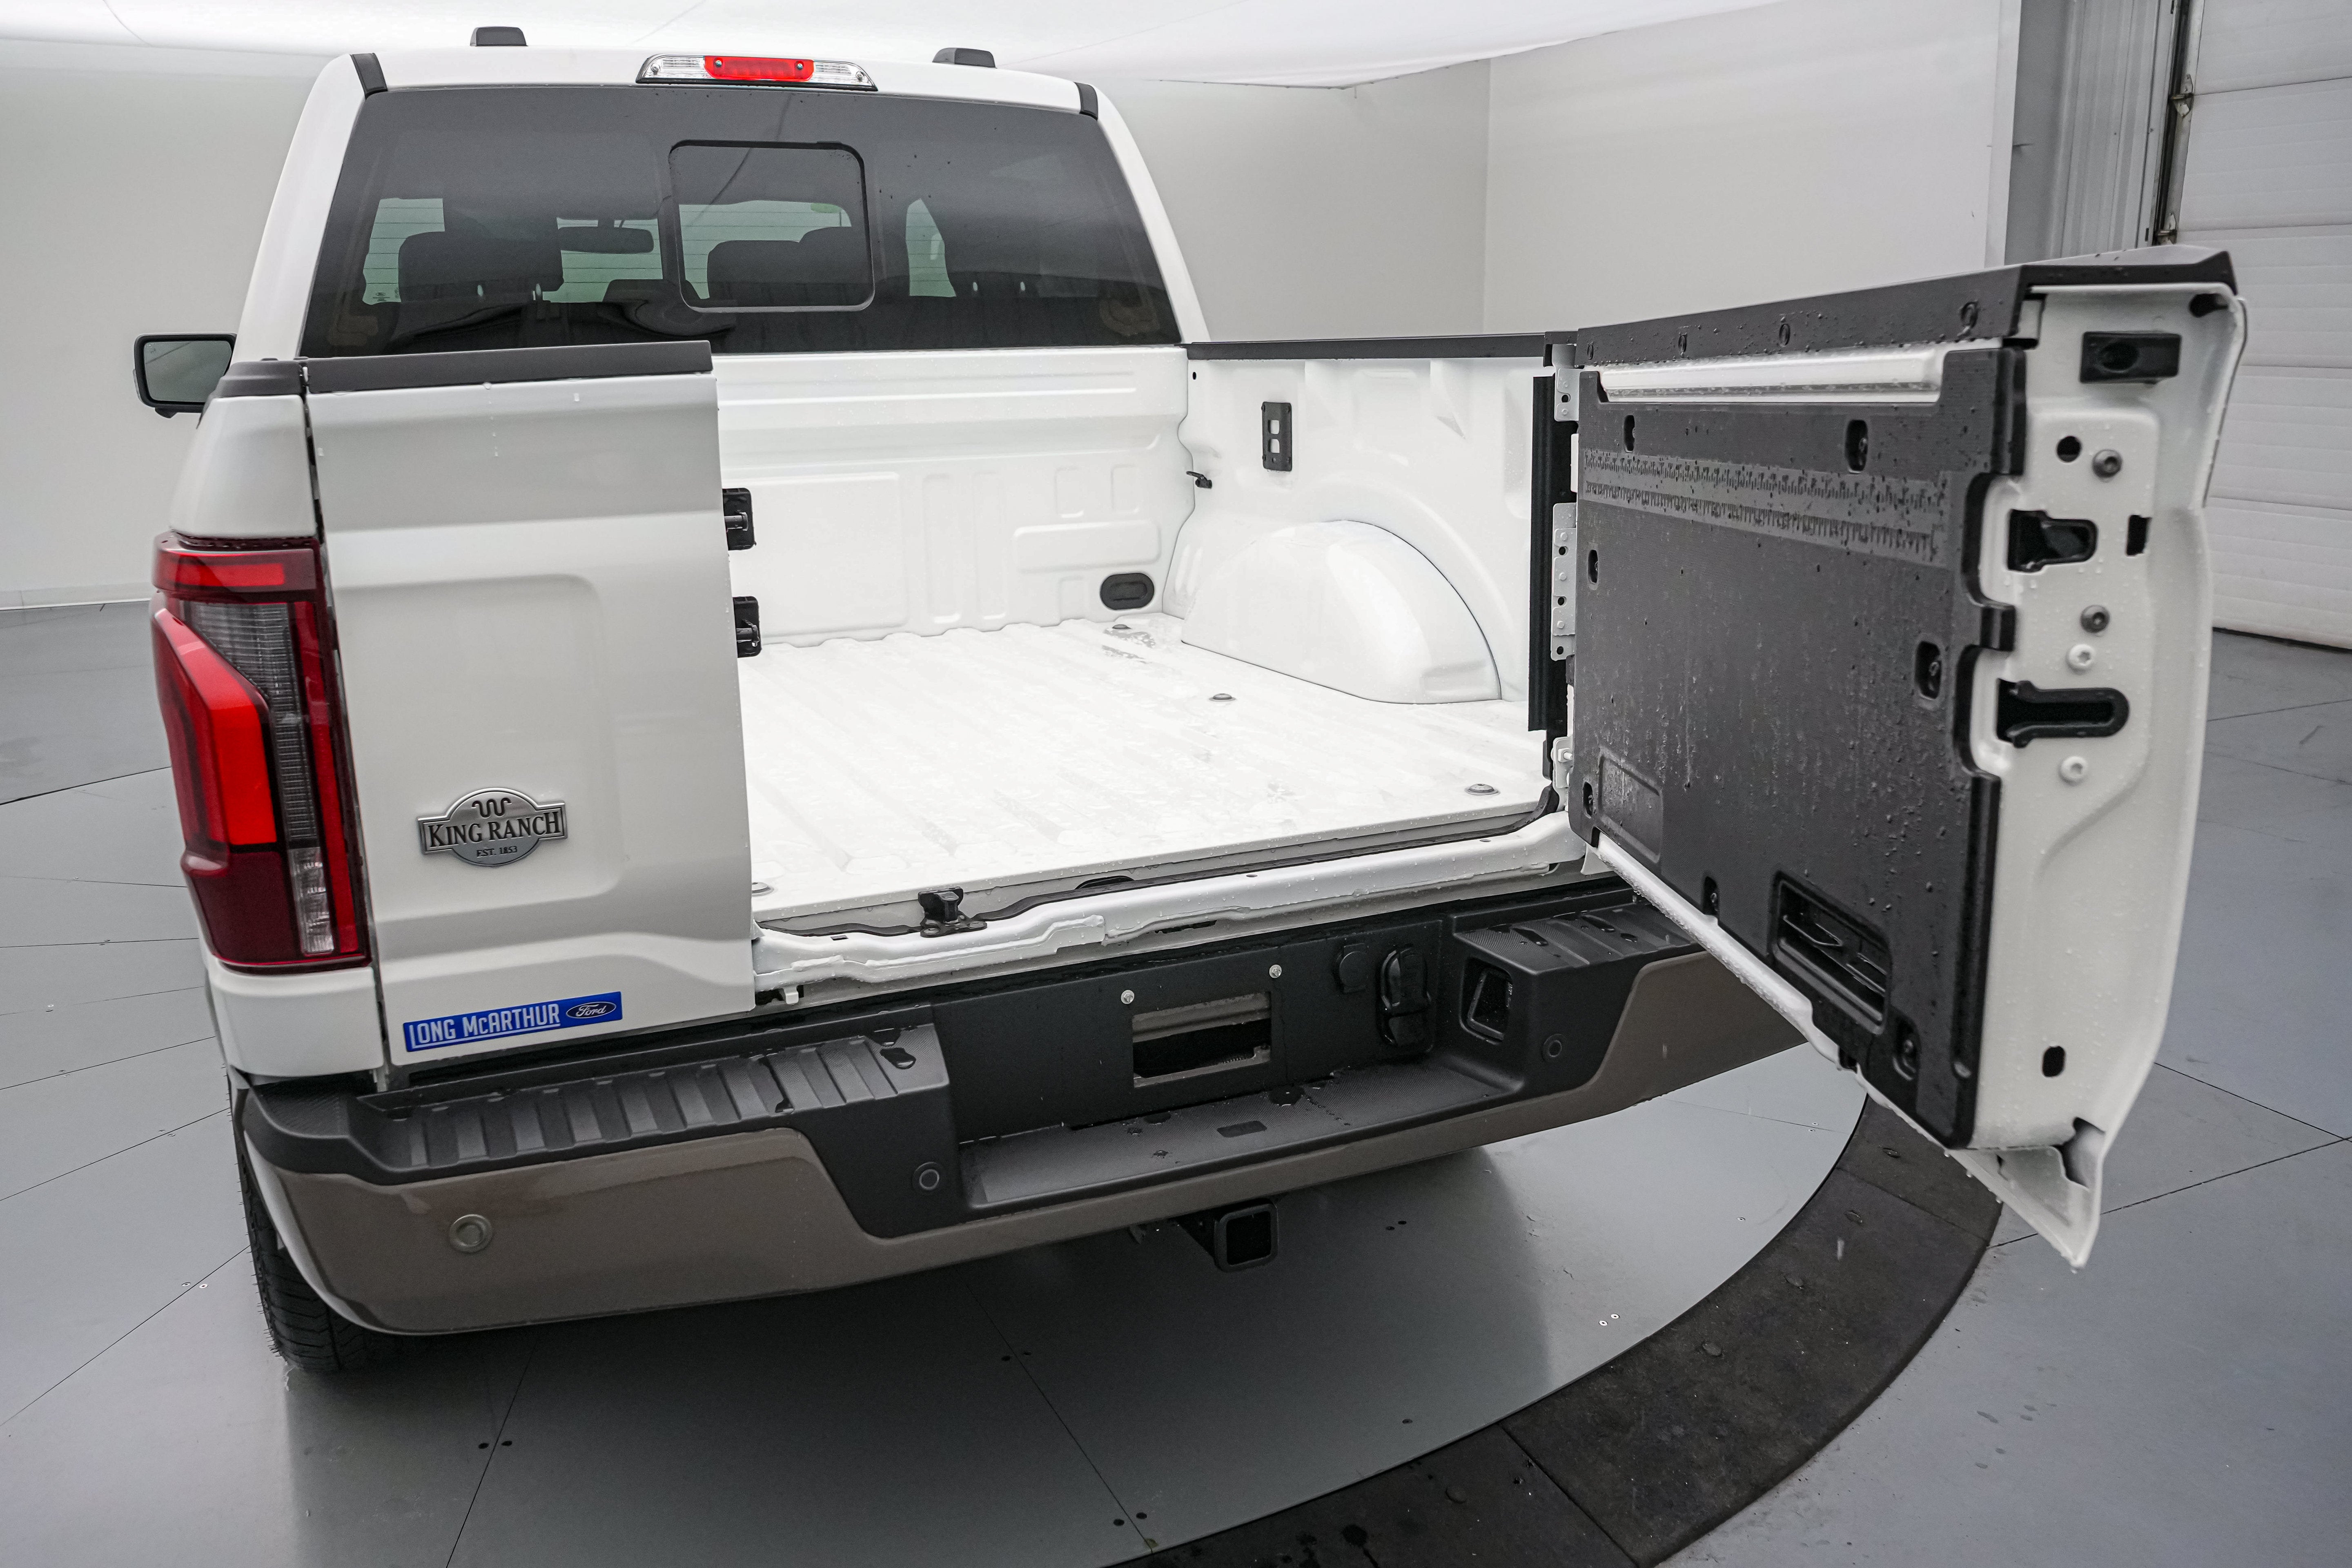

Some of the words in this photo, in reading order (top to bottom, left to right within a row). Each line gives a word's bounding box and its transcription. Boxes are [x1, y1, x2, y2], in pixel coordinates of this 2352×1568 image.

[428, 823, 483, 848] KING
[488, 811, 561, 842] RANCH
[476, 848, 497, 858] EST.
[499, 845, 517, 855] 1853
[575, 1004, 607, 1018] Ford
[409, 1019, 456, 1049] LONG
[463, 1003, 560, 1038] McARTHUR
